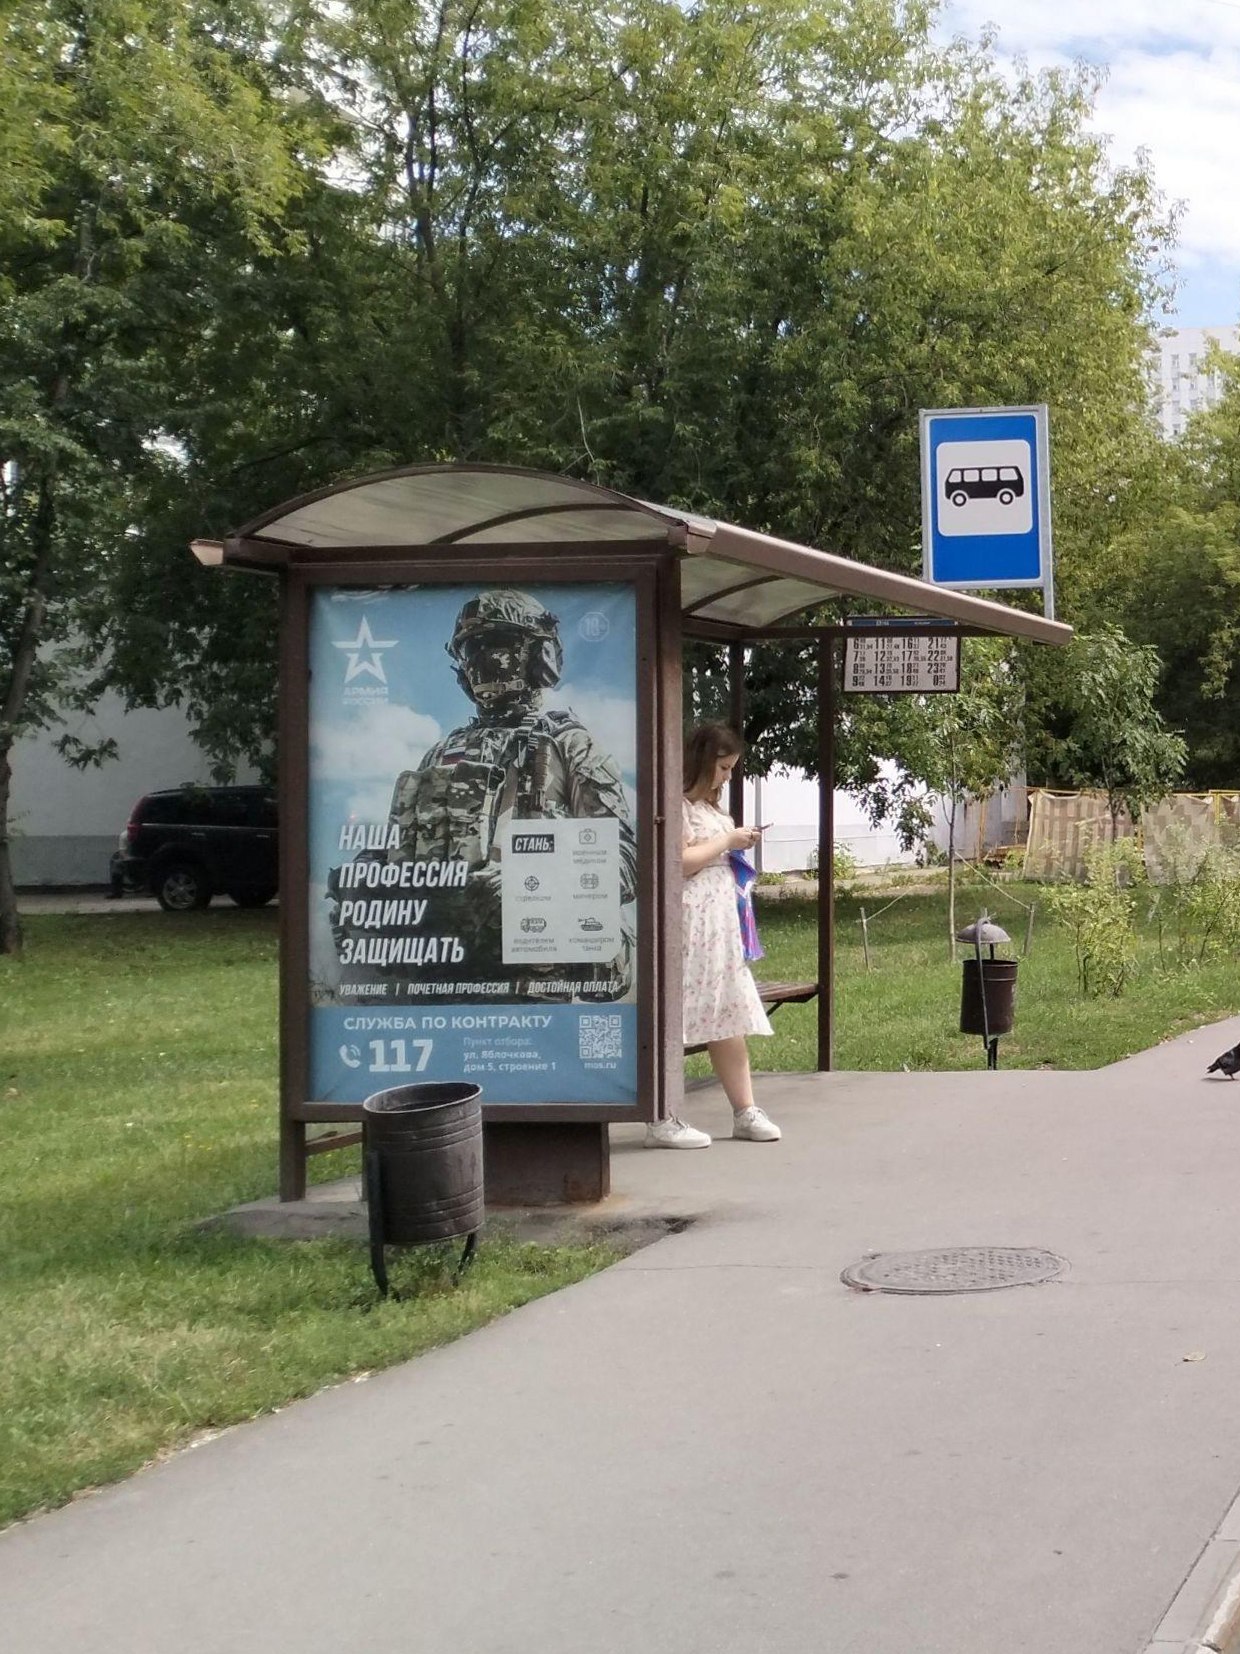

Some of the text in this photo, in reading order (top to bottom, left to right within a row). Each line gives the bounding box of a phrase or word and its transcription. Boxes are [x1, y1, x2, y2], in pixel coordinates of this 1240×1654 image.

[875, 638, 885, 649] 11
[902, 637, 913, 649] 16
[928, 637, 939, 649] 21
[853, 651, 859, 662] 7
[874, 651, 886, 662] 12
[902, 650, 912, 661] 17
[928, 650, 939, 661] 22
[874, 663, 885, 674] 13
[902, 663, 912, 674] 18
[928, 662, 939, 674] 23
[852, 675, 859, 687] 9
[874, 675, 885, 686] 14
[338, 823, 401, 850] НАША
[514, 836, 554, 852] СТАНЬ:
[338, 861, 469, 888] ПРОФЕССИЯ
[338, 899, 428, 930] РОДИНУ
[339, 936, 465, 967] ЗАЩИЩАТЬ
[339, 983, 388, 996] УВАЖЕНИЕ
[407, 982, 511, 995] ПОЧЕТНАЯ ПРОФЕССИЯ
[528, 980, 620, 994] ДОСТОЙНАЯ ОПЛАТА
[343, 1015, 553, 1030] СЛУЖБА ПО КОНТРАКТУ
[369, 1039, 433, 1073] 117
[463, 1051, 479, 1061] ул.
[463, 1063, 485, 1073] дом
[498, 1063, 548, 1072] строение
[551, 1062, 557, 1070] 1
